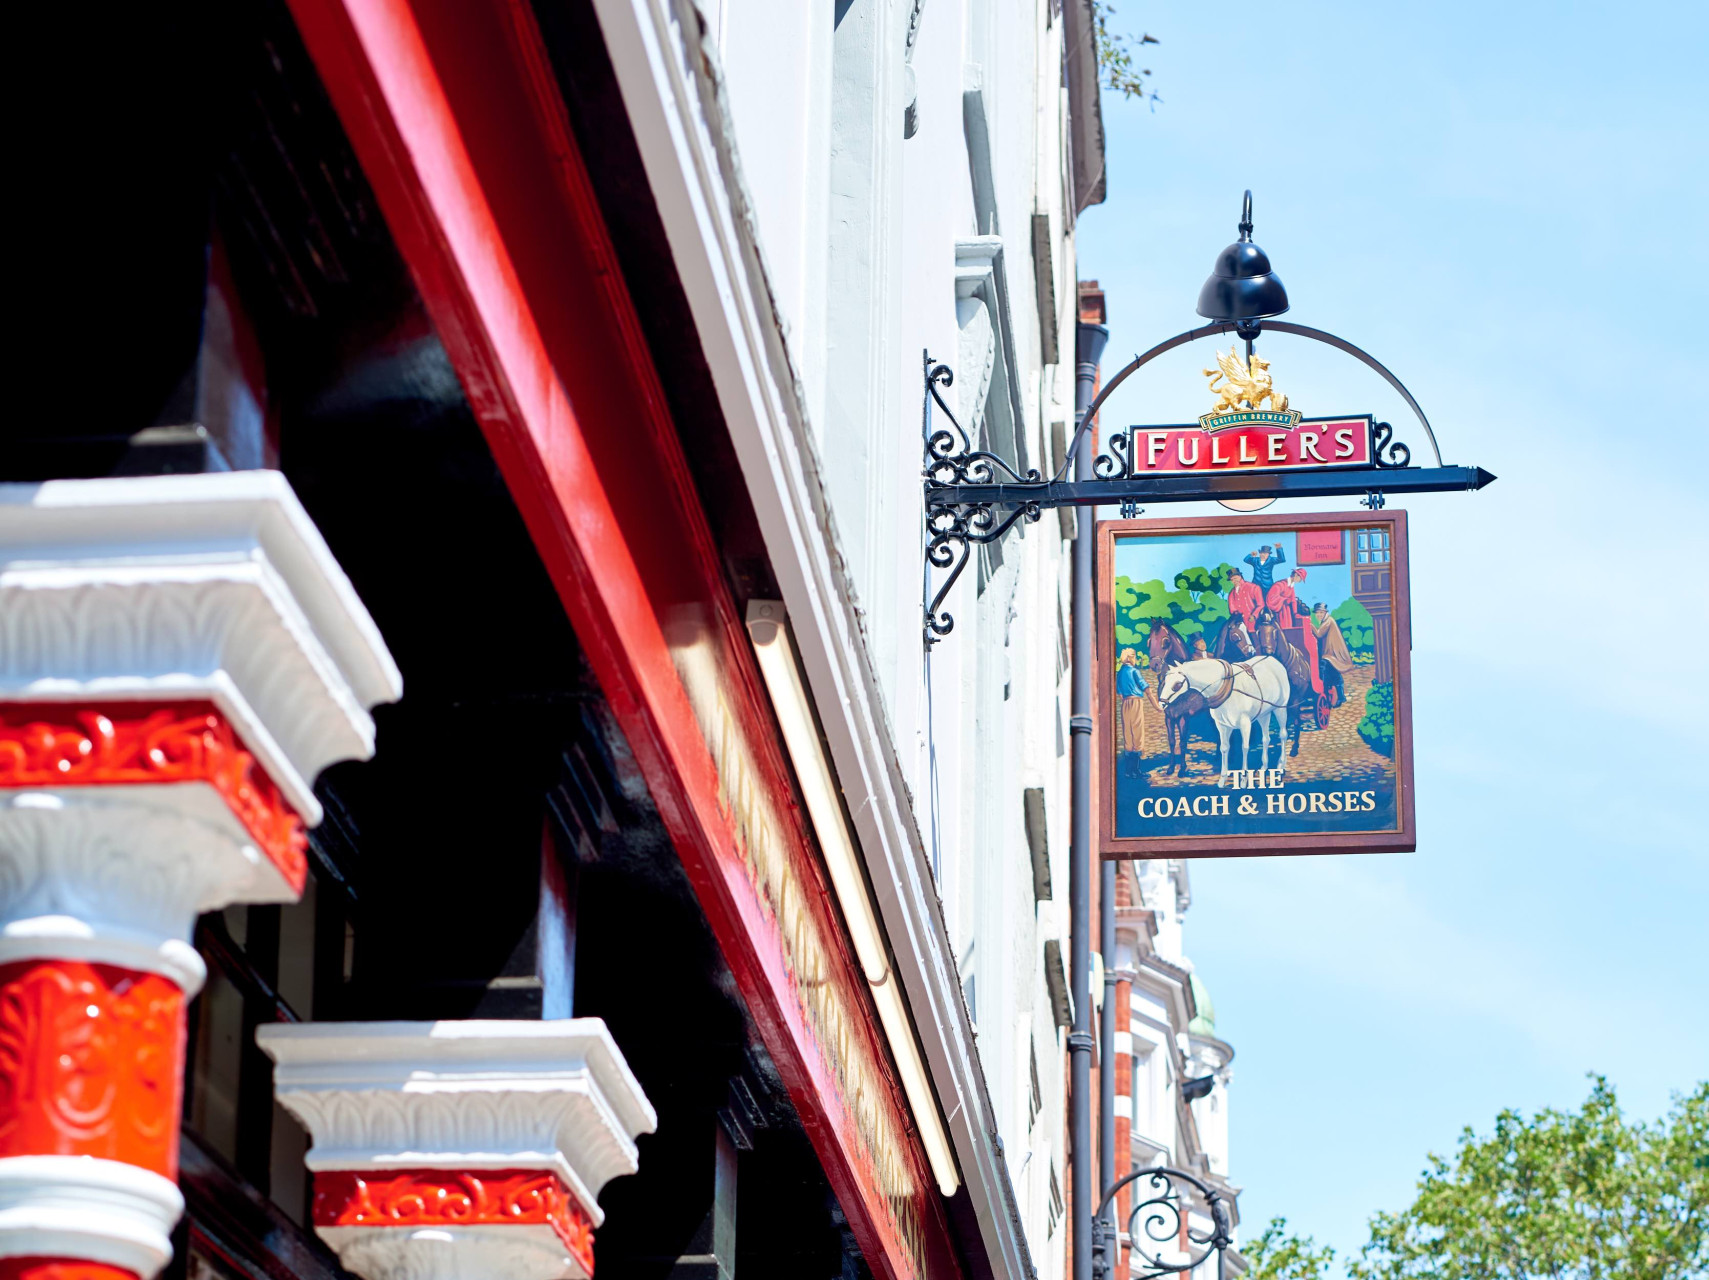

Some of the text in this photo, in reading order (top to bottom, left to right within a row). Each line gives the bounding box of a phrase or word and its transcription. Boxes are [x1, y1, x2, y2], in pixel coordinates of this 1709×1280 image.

[1212, 412, 1289, 426] GRIFFIN BREWERY
[1147, 424, 1355, 466] FULLER'S
[1226, 768, 1284, 790] THE
[1137, 791, 1376, 818] COACH & HORSES
